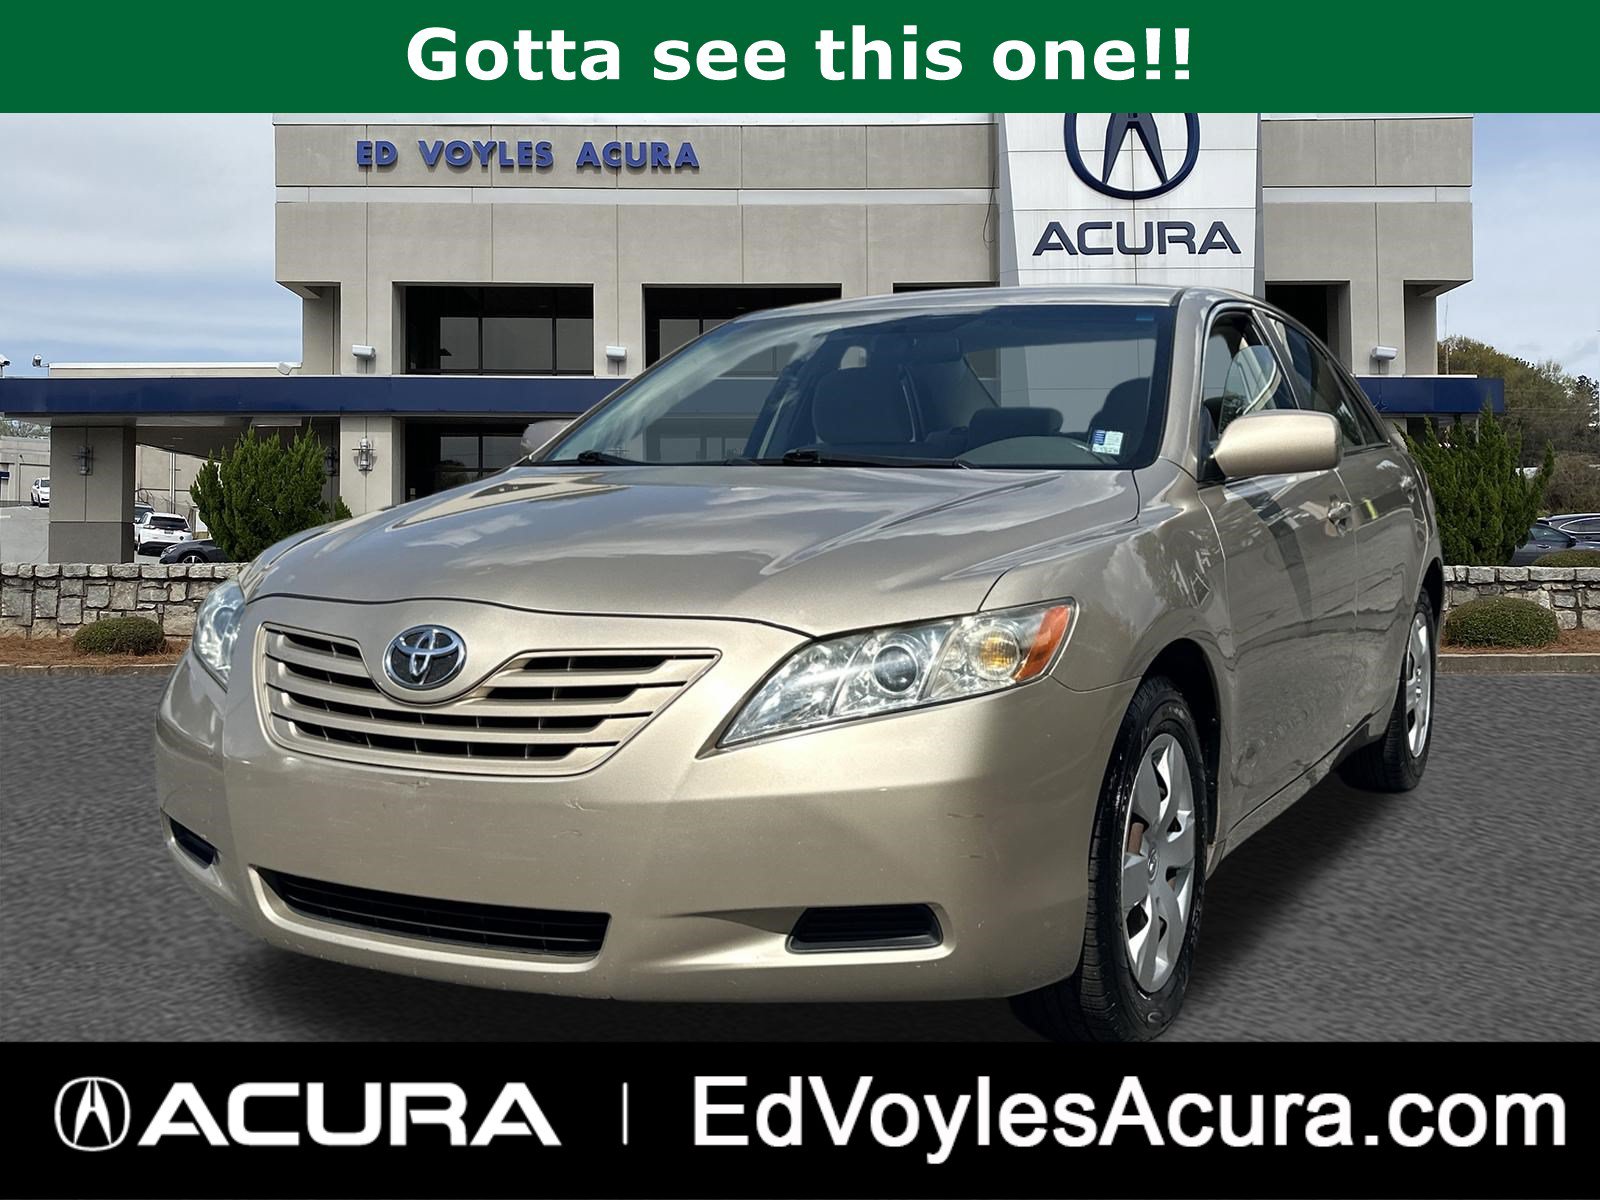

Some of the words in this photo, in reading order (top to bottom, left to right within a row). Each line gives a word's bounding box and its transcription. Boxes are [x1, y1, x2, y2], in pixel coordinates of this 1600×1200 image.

[356, 140, 398, 167] ED
[418, 140, 555, 168] VOYLES
[576, 141, 700, 168] ACURA
[1032, 221, 1242, 256] ACURA
